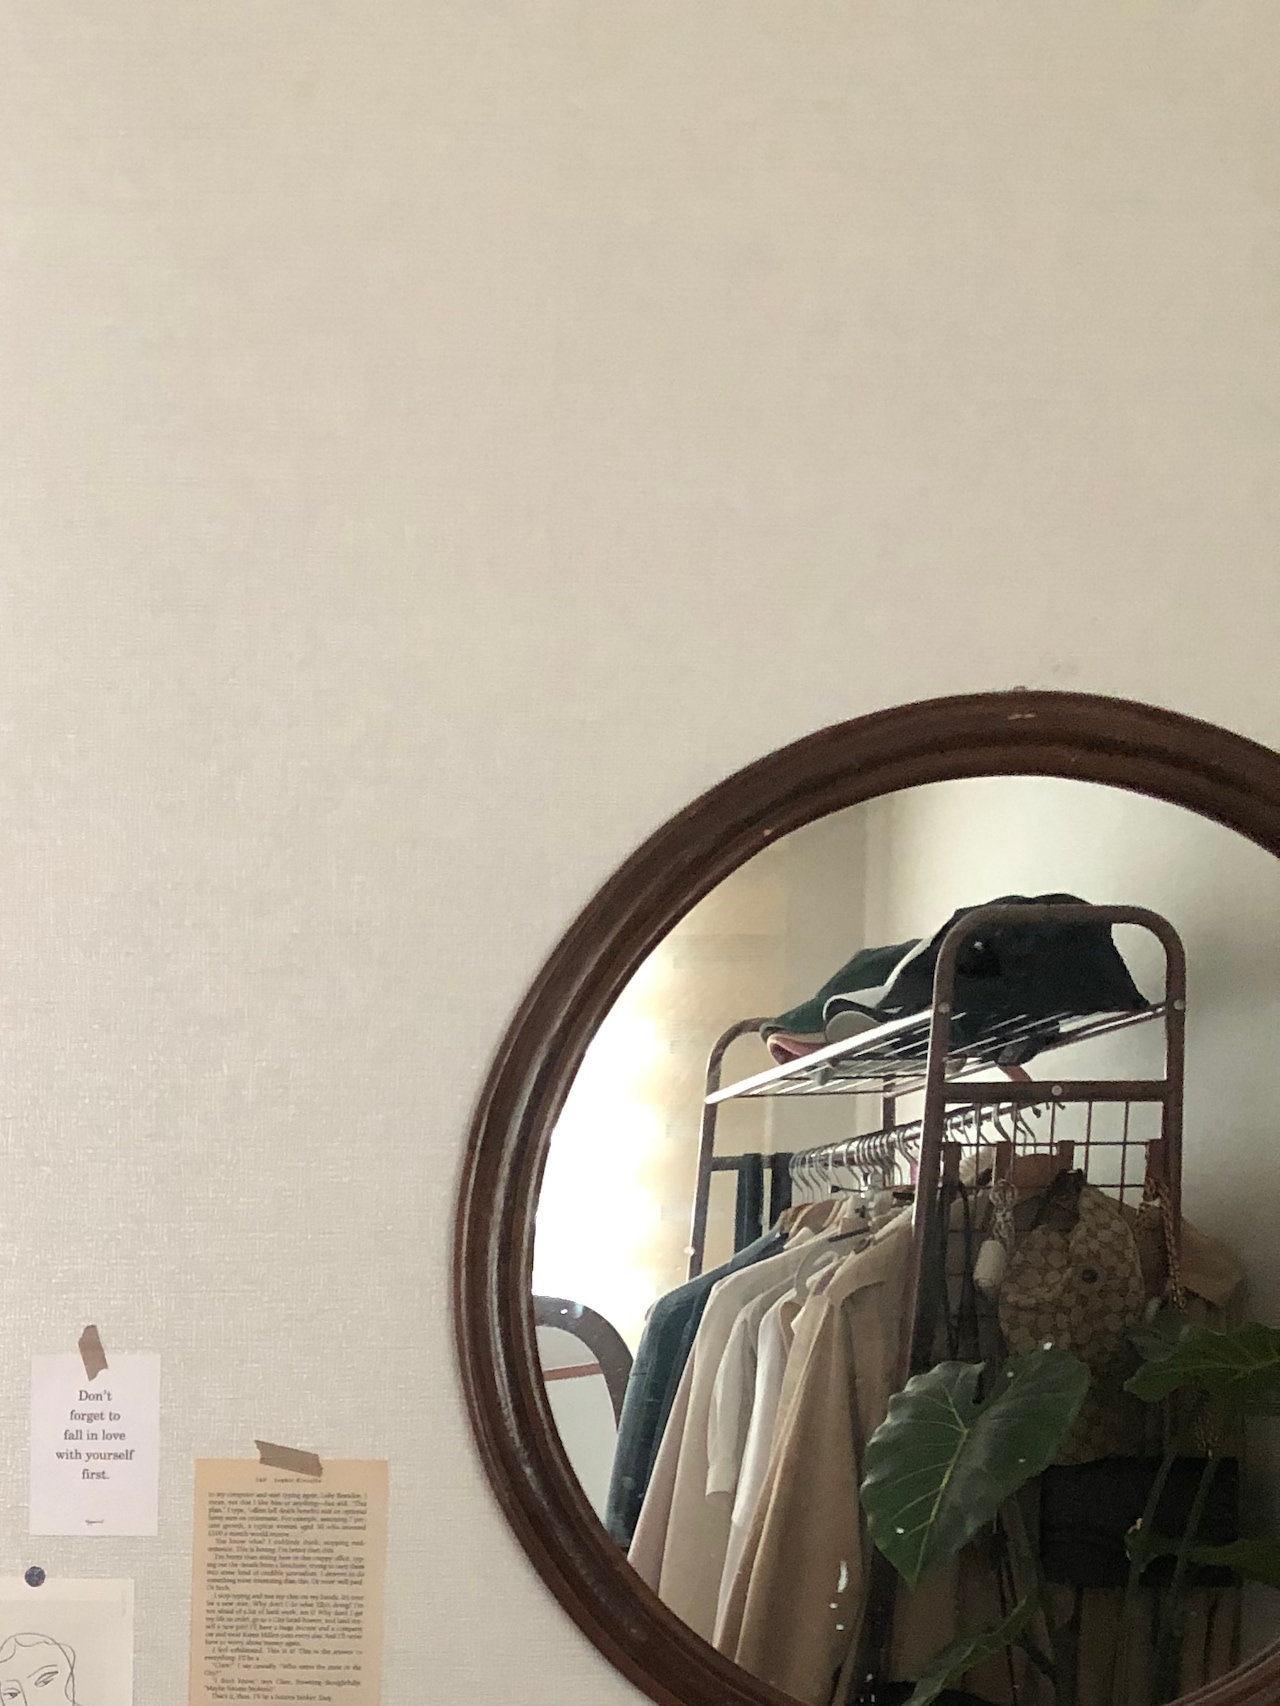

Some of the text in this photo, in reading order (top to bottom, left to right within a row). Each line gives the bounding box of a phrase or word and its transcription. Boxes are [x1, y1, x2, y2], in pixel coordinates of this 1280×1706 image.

[78, 1390, 112, 1401] Don't
[70, 1410, 121, 1423] forget to
[64, 1429, 126, 1440] fall in love
[56, 1449, 135, 1462] with yourself
[82, 1469, 110, 1480] first.
